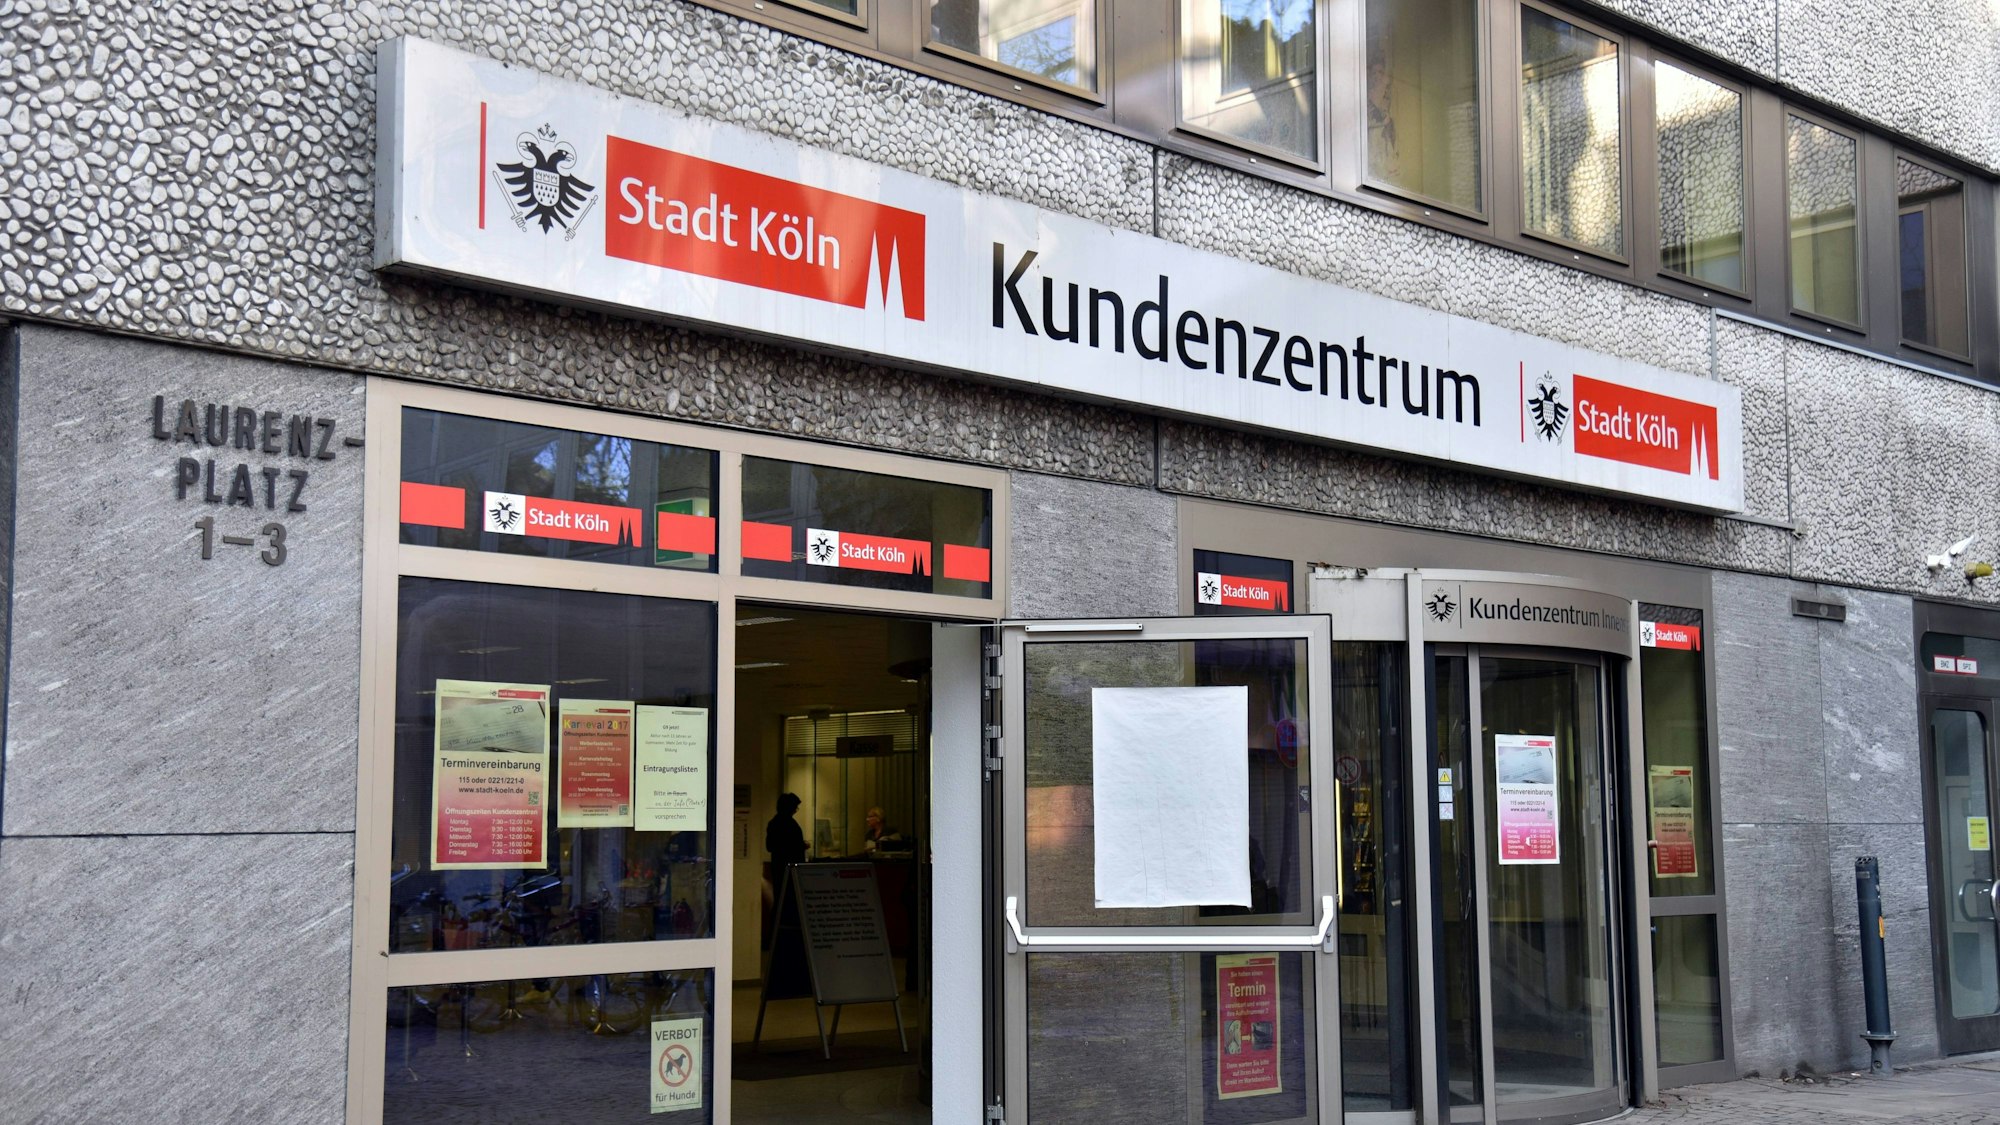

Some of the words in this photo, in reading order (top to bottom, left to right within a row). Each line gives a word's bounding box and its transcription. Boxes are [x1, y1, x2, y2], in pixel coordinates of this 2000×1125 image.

[618, 176, 739, 248] Stadt
[751, 206, 841, 271] Köln
[991, 241, 1482, 427] Kundenzentrum
[152, 394, 366, 461] LAURENZ-
[1578, 399, 1632, 441] Stadt
[1636, 411, 1679, 450] Köln
[177, 456, 309, 512] PLATZ
[528, 508, 571, 529] Stadt
[574, 513, 610, 533] Köln
[841, 542, 875, 560] Stadt
[877, 547, 905, 563] Köln
[1222, 583, 1247, 598] Stadt
[1248, 586, 1270, 601] Köln
[1469, 597, 1600, 628] Kundenzentrum
[1655, 629, 1673, 642] Stadt
[1673, 631, 1688, 643] Köln
[608, 720, 628, 730] 2017
[440, 758, 541, 772] Terminvereinbarung
[643, 765, 698, 774] Eintragungslisten
[458, 786, 524, 794] www.stadt-koeln.de
[1500, 788, 1554, 797] Terminvereinbarung
[1228, 981, 1266, 998] Termin
[655, 1028, 698, 1041] VERBOT
[656, 1094, 668, 1102] für
[669, 1090, 696, 1101] Hunde
